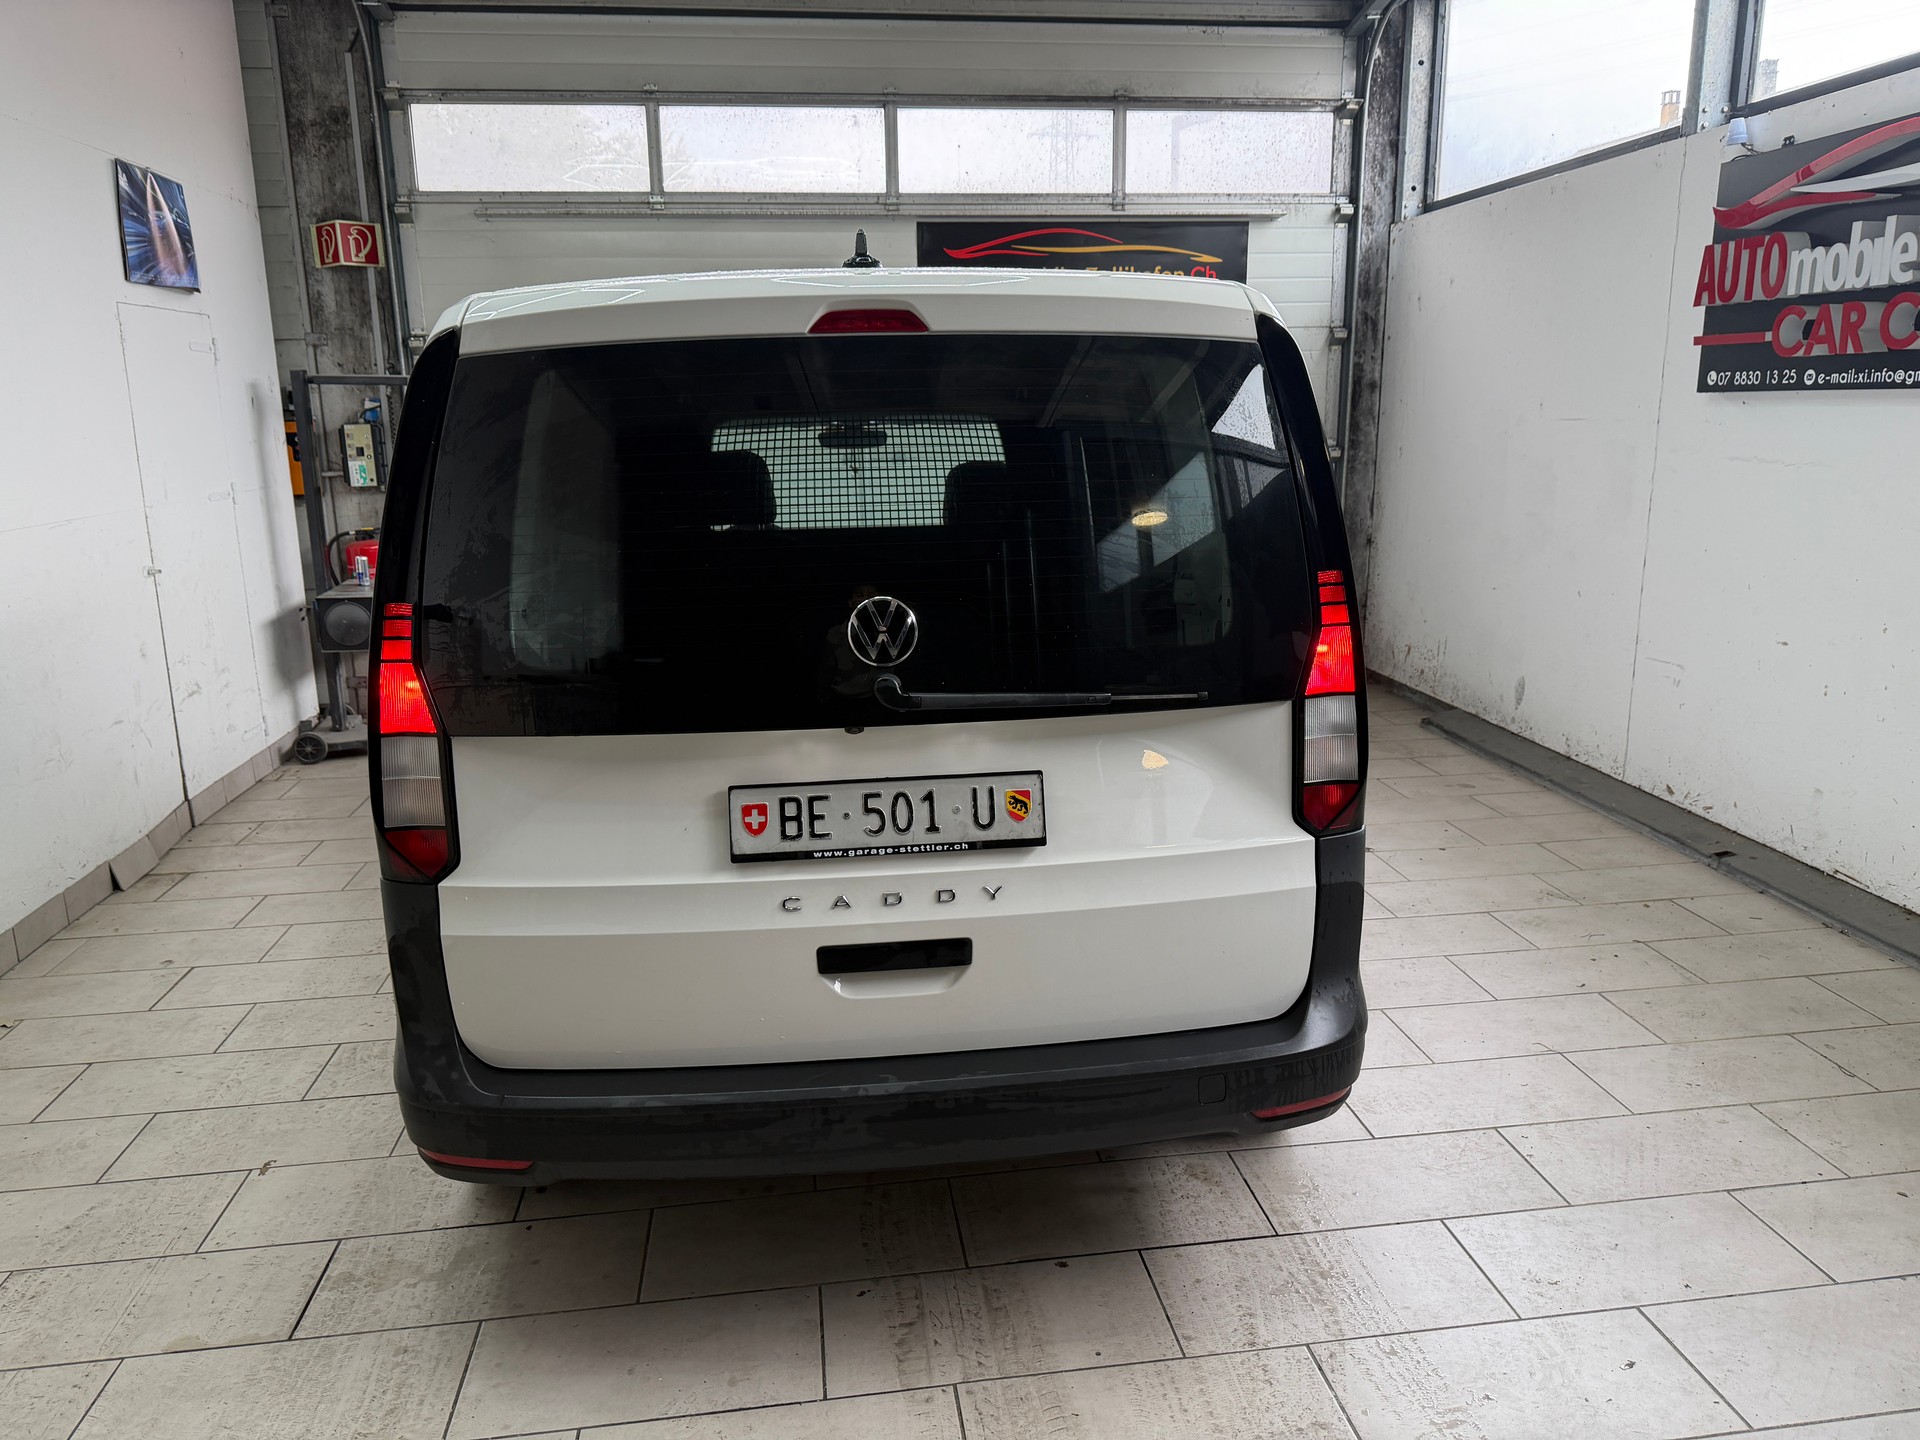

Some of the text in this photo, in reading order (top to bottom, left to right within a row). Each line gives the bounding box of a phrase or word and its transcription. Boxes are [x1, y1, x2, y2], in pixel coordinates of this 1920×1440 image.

[1771, 301, 1867, 357] CAR
[1717, 371, 1732, 386] 07
[1733, 370, 1761, 385] 8830
[1766, 369, 1779, 385] 13
[1782, 369, 1797, 384] 25
[778, 785, 996, 842] BE 501 U
[813, 842, 969, 858] www.garage-stettler.ch
[782, 884, 1004, 913] CADDY
